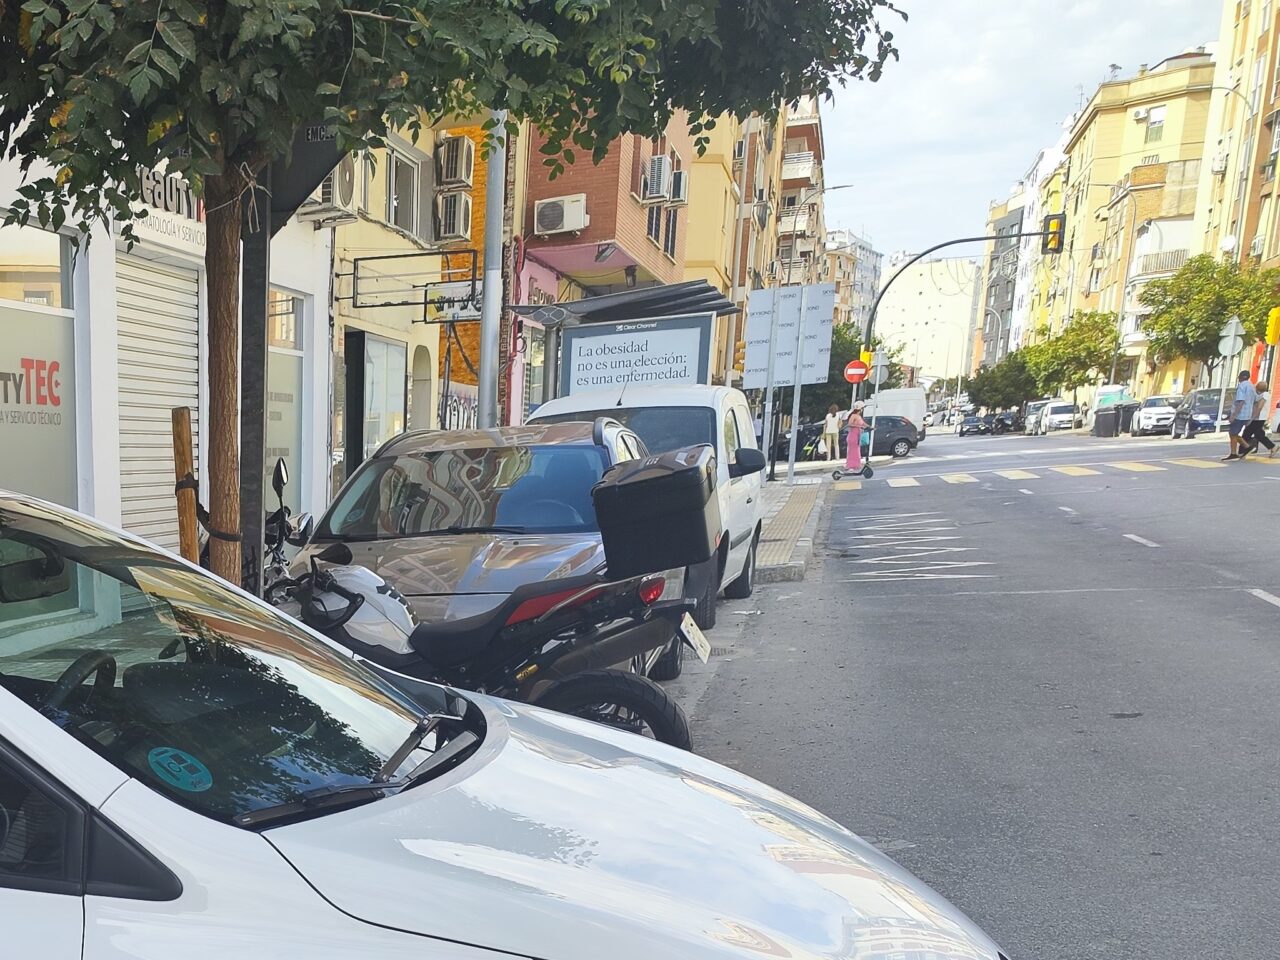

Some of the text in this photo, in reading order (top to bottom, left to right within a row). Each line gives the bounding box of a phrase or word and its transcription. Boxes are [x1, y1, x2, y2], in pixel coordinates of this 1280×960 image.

[578, 340, 648, 357] La obesidad
[577, 352, 687, 372] no es una elección:
[576, 366, 690, 386] es una enfermedad.
[10, 409, 36, 424] SERVICIO
[37, 408, 62, 426] TÉCNICO
